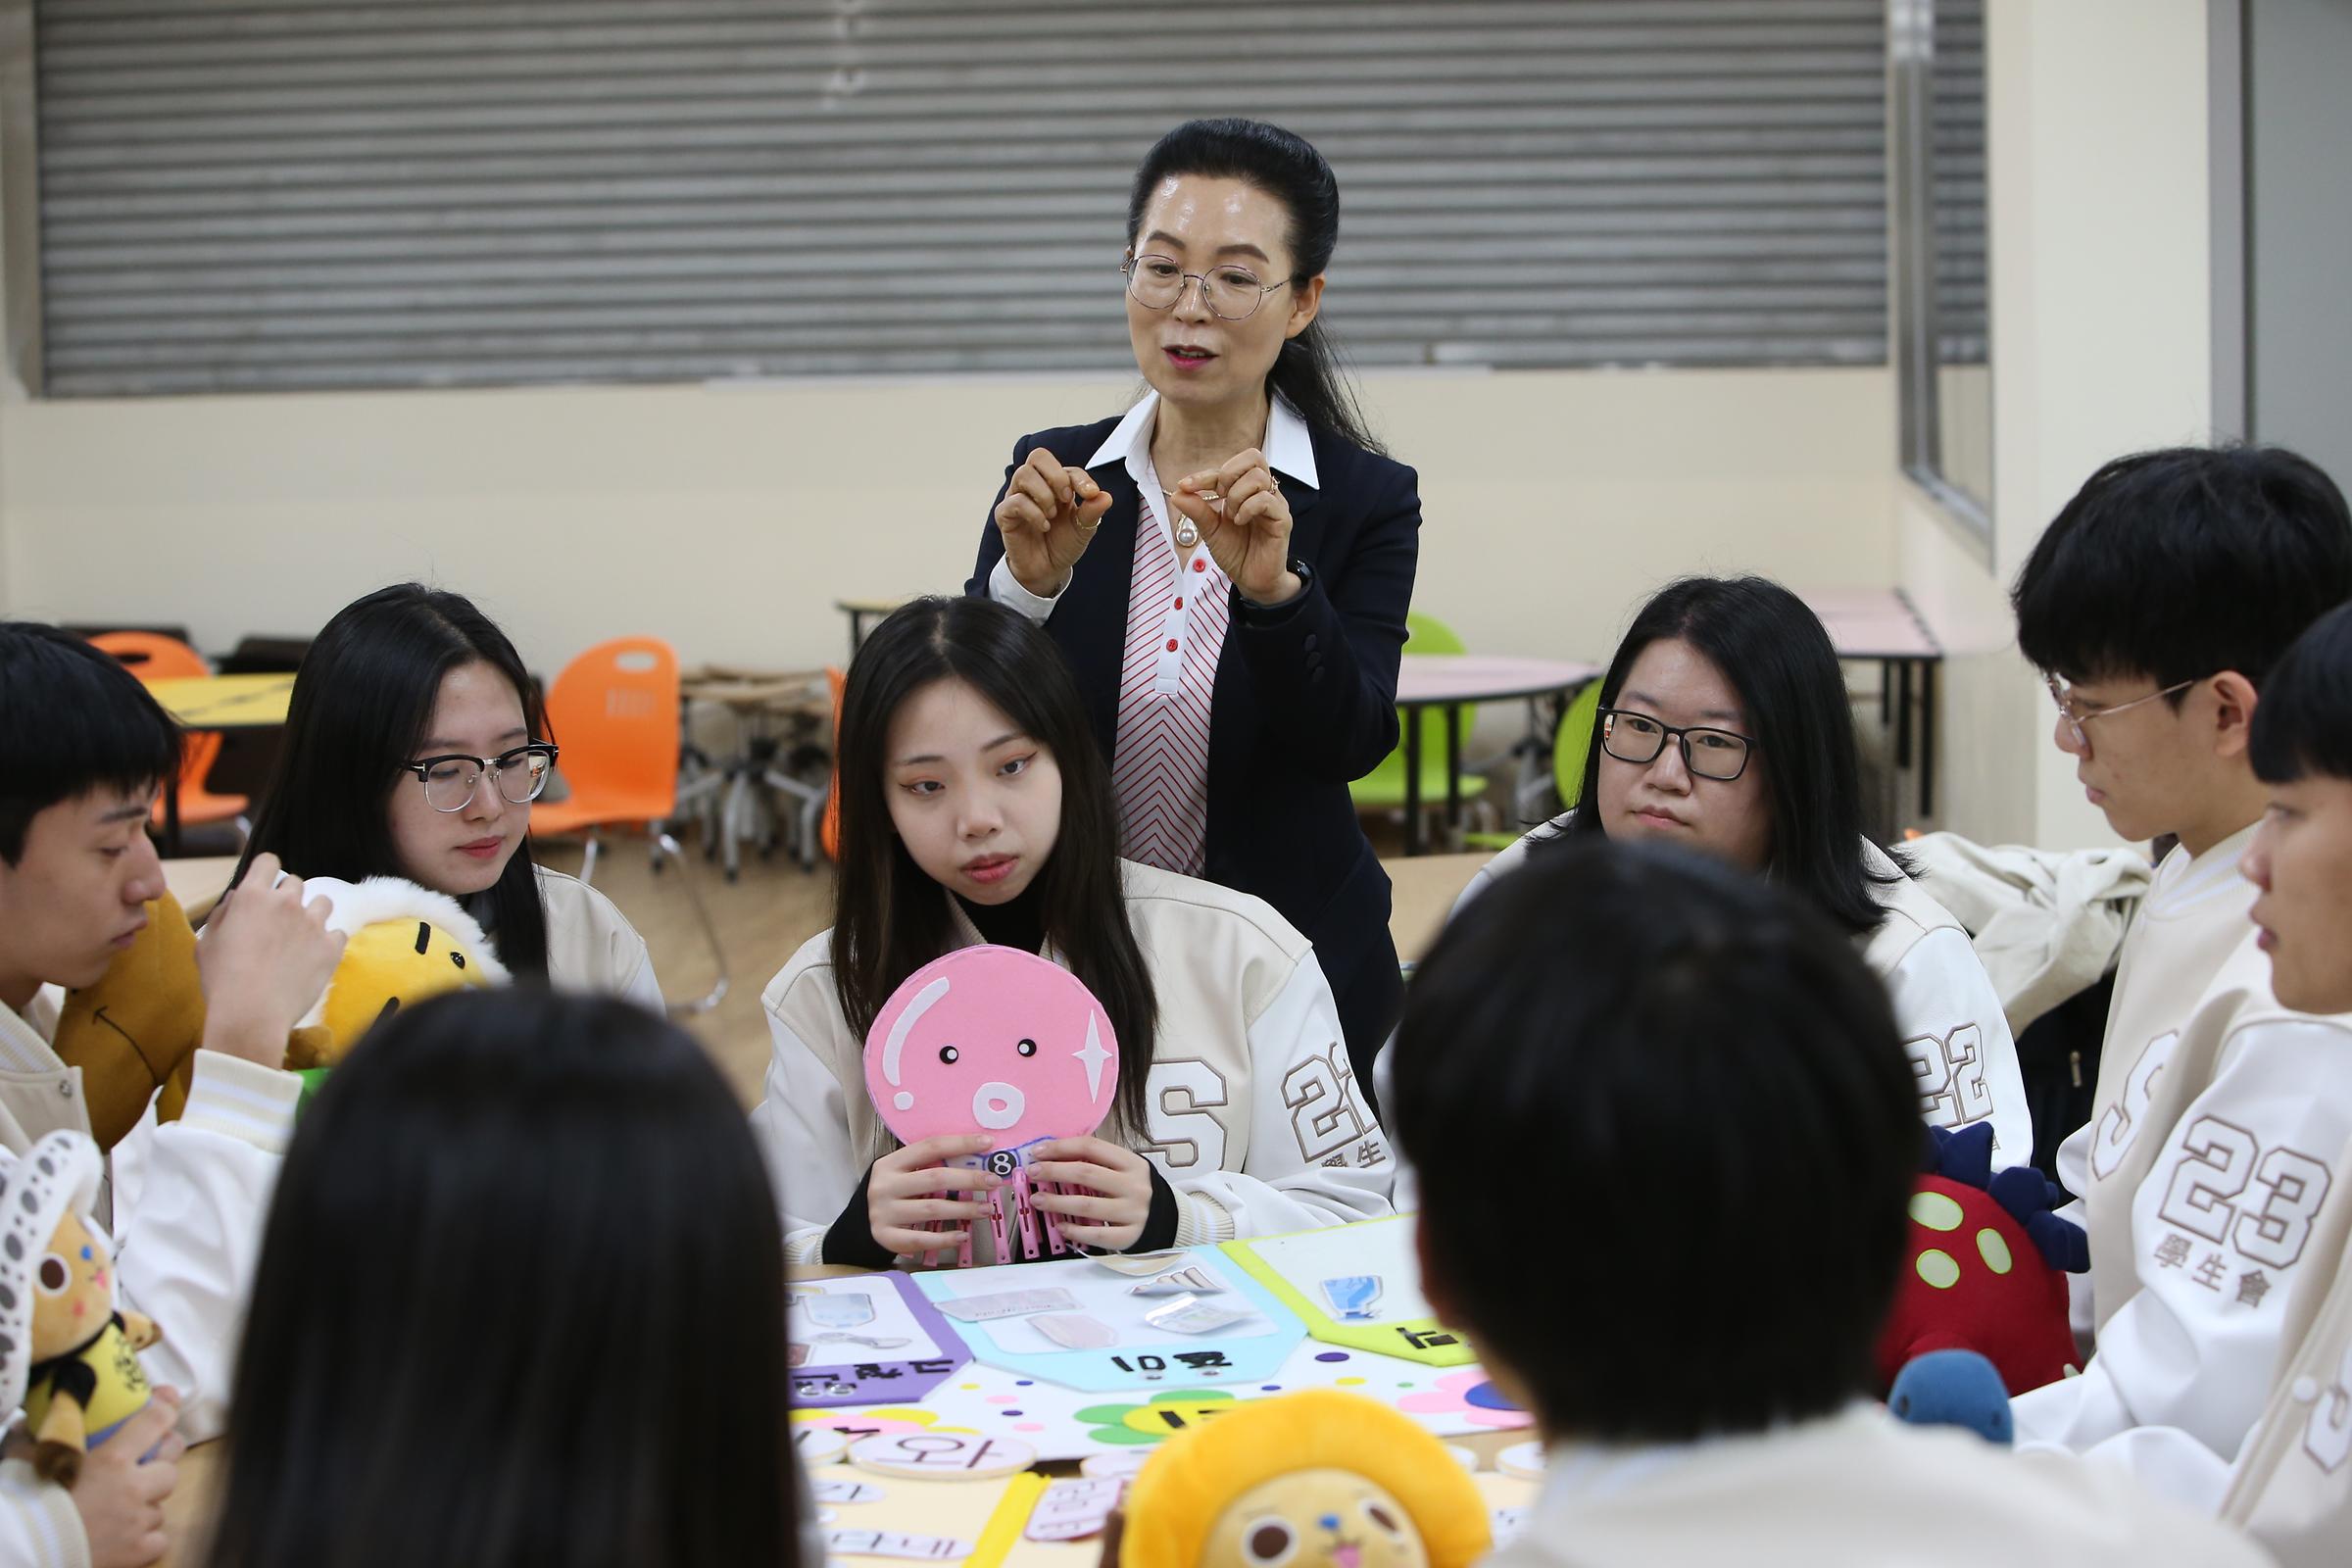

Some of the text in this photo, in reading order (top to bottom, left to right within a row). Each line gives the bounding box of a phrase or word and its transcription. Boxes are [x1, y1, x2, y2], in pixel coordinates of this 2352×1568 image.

[1135, 1057, 1229, 1171] S
[2158, 1113, 2332, 1270] 23
[2153, 1234, 2274, 1311] 學生會
